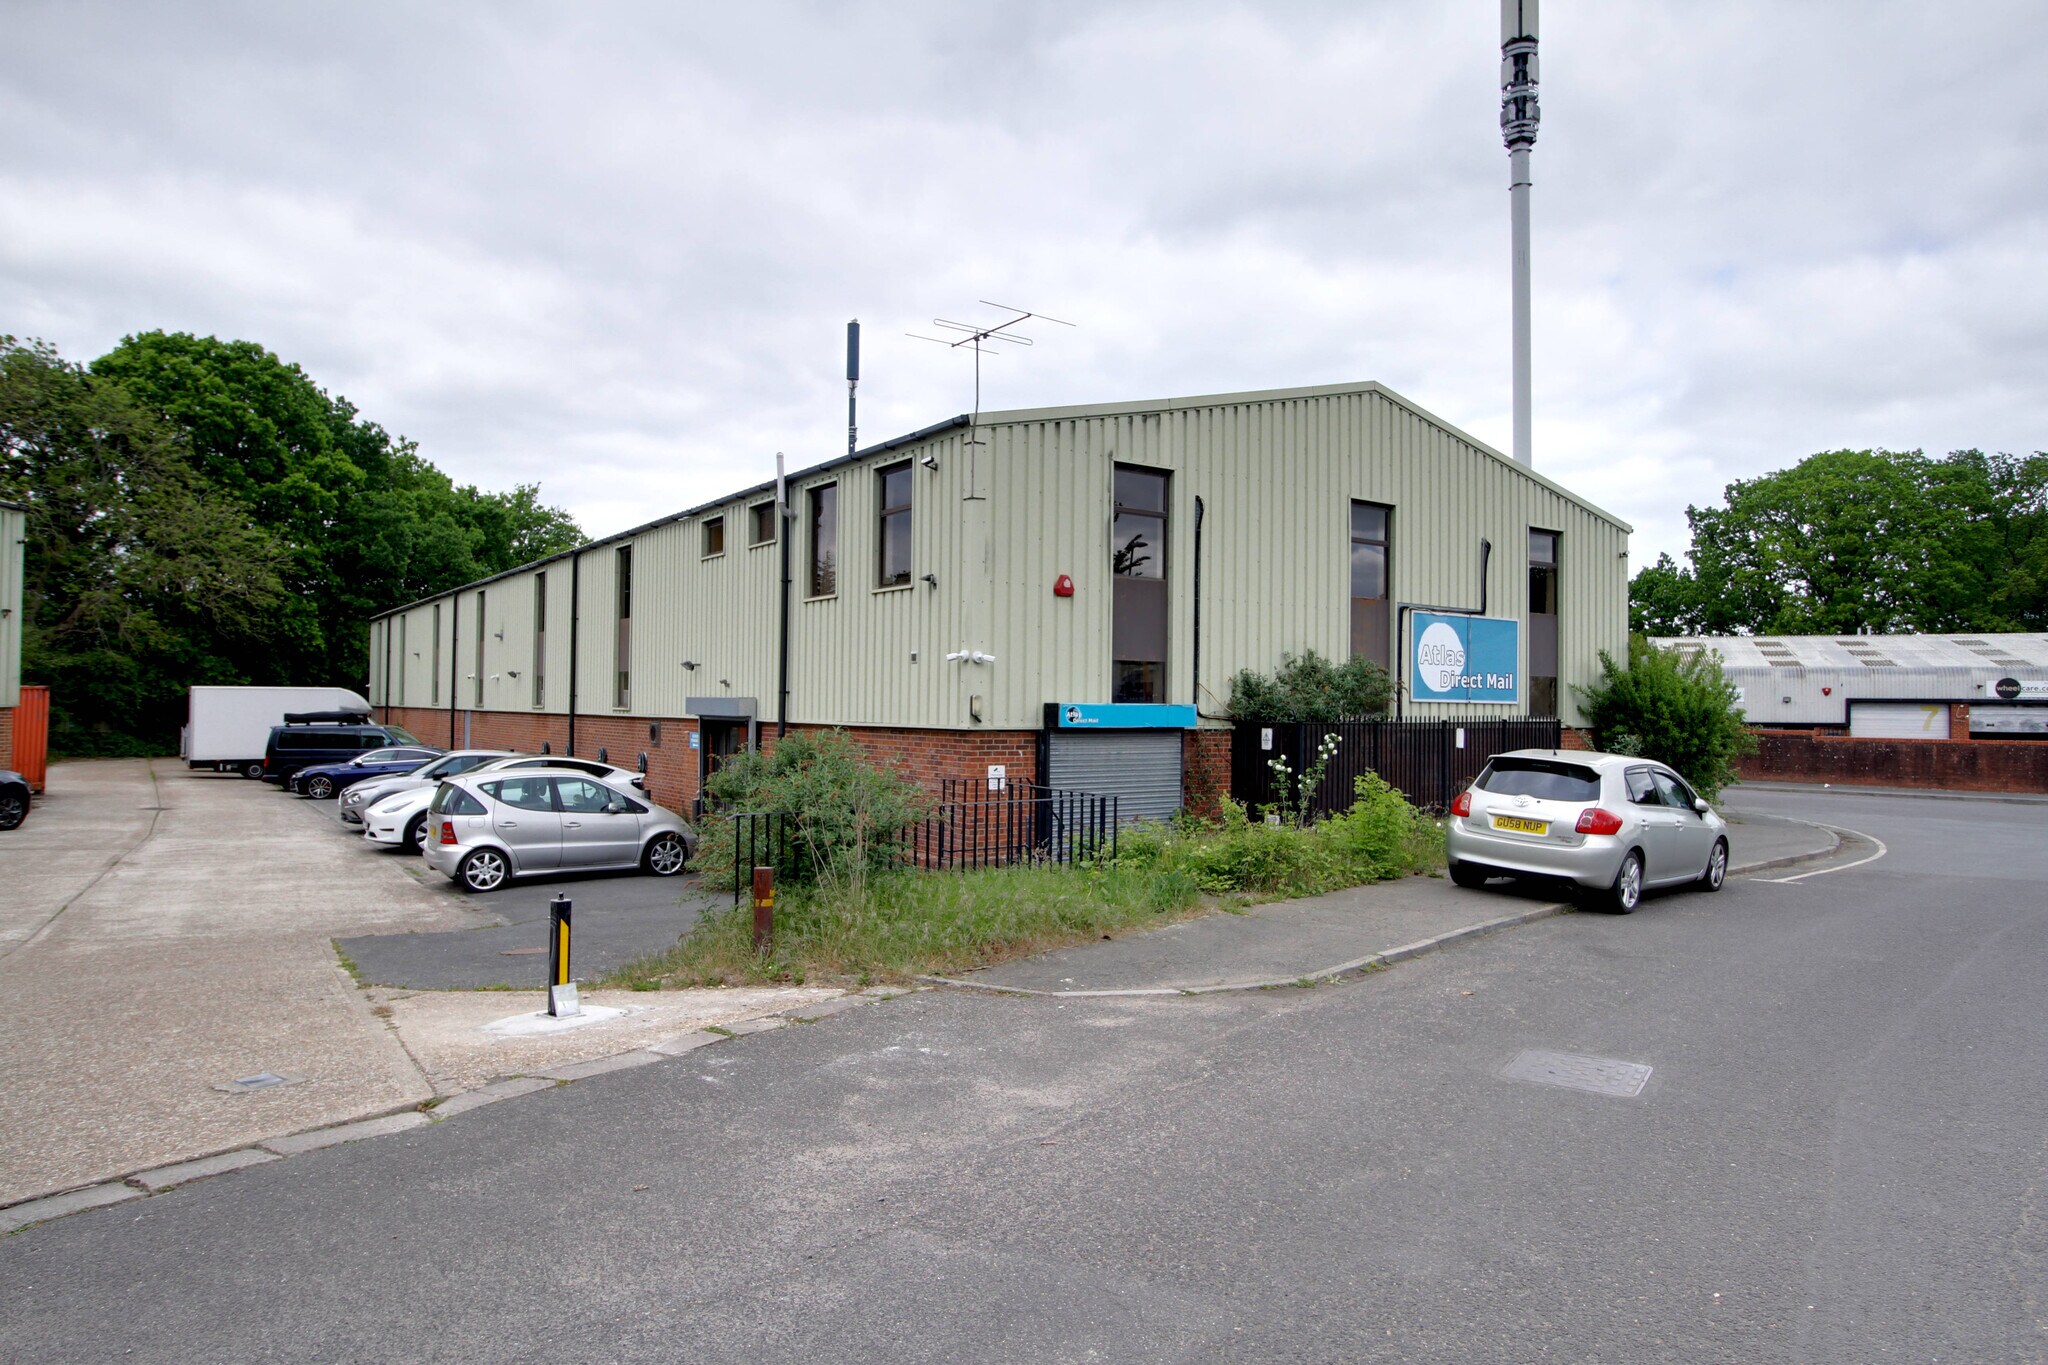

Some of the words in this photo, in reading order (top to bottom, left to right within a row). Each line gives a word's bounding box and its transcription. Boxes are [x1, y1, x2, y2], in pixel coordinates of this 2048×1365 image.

[1419, 644, 1466, 667] Atlas
[1440, 670, 1483, 688] Direct
[1486, 672, 1513, 690] Mail
[1920, 704, 1939, 732] 7
[1496, 817, 1521, 829] GU58
[1523, 820, 1543, 831] NUP
